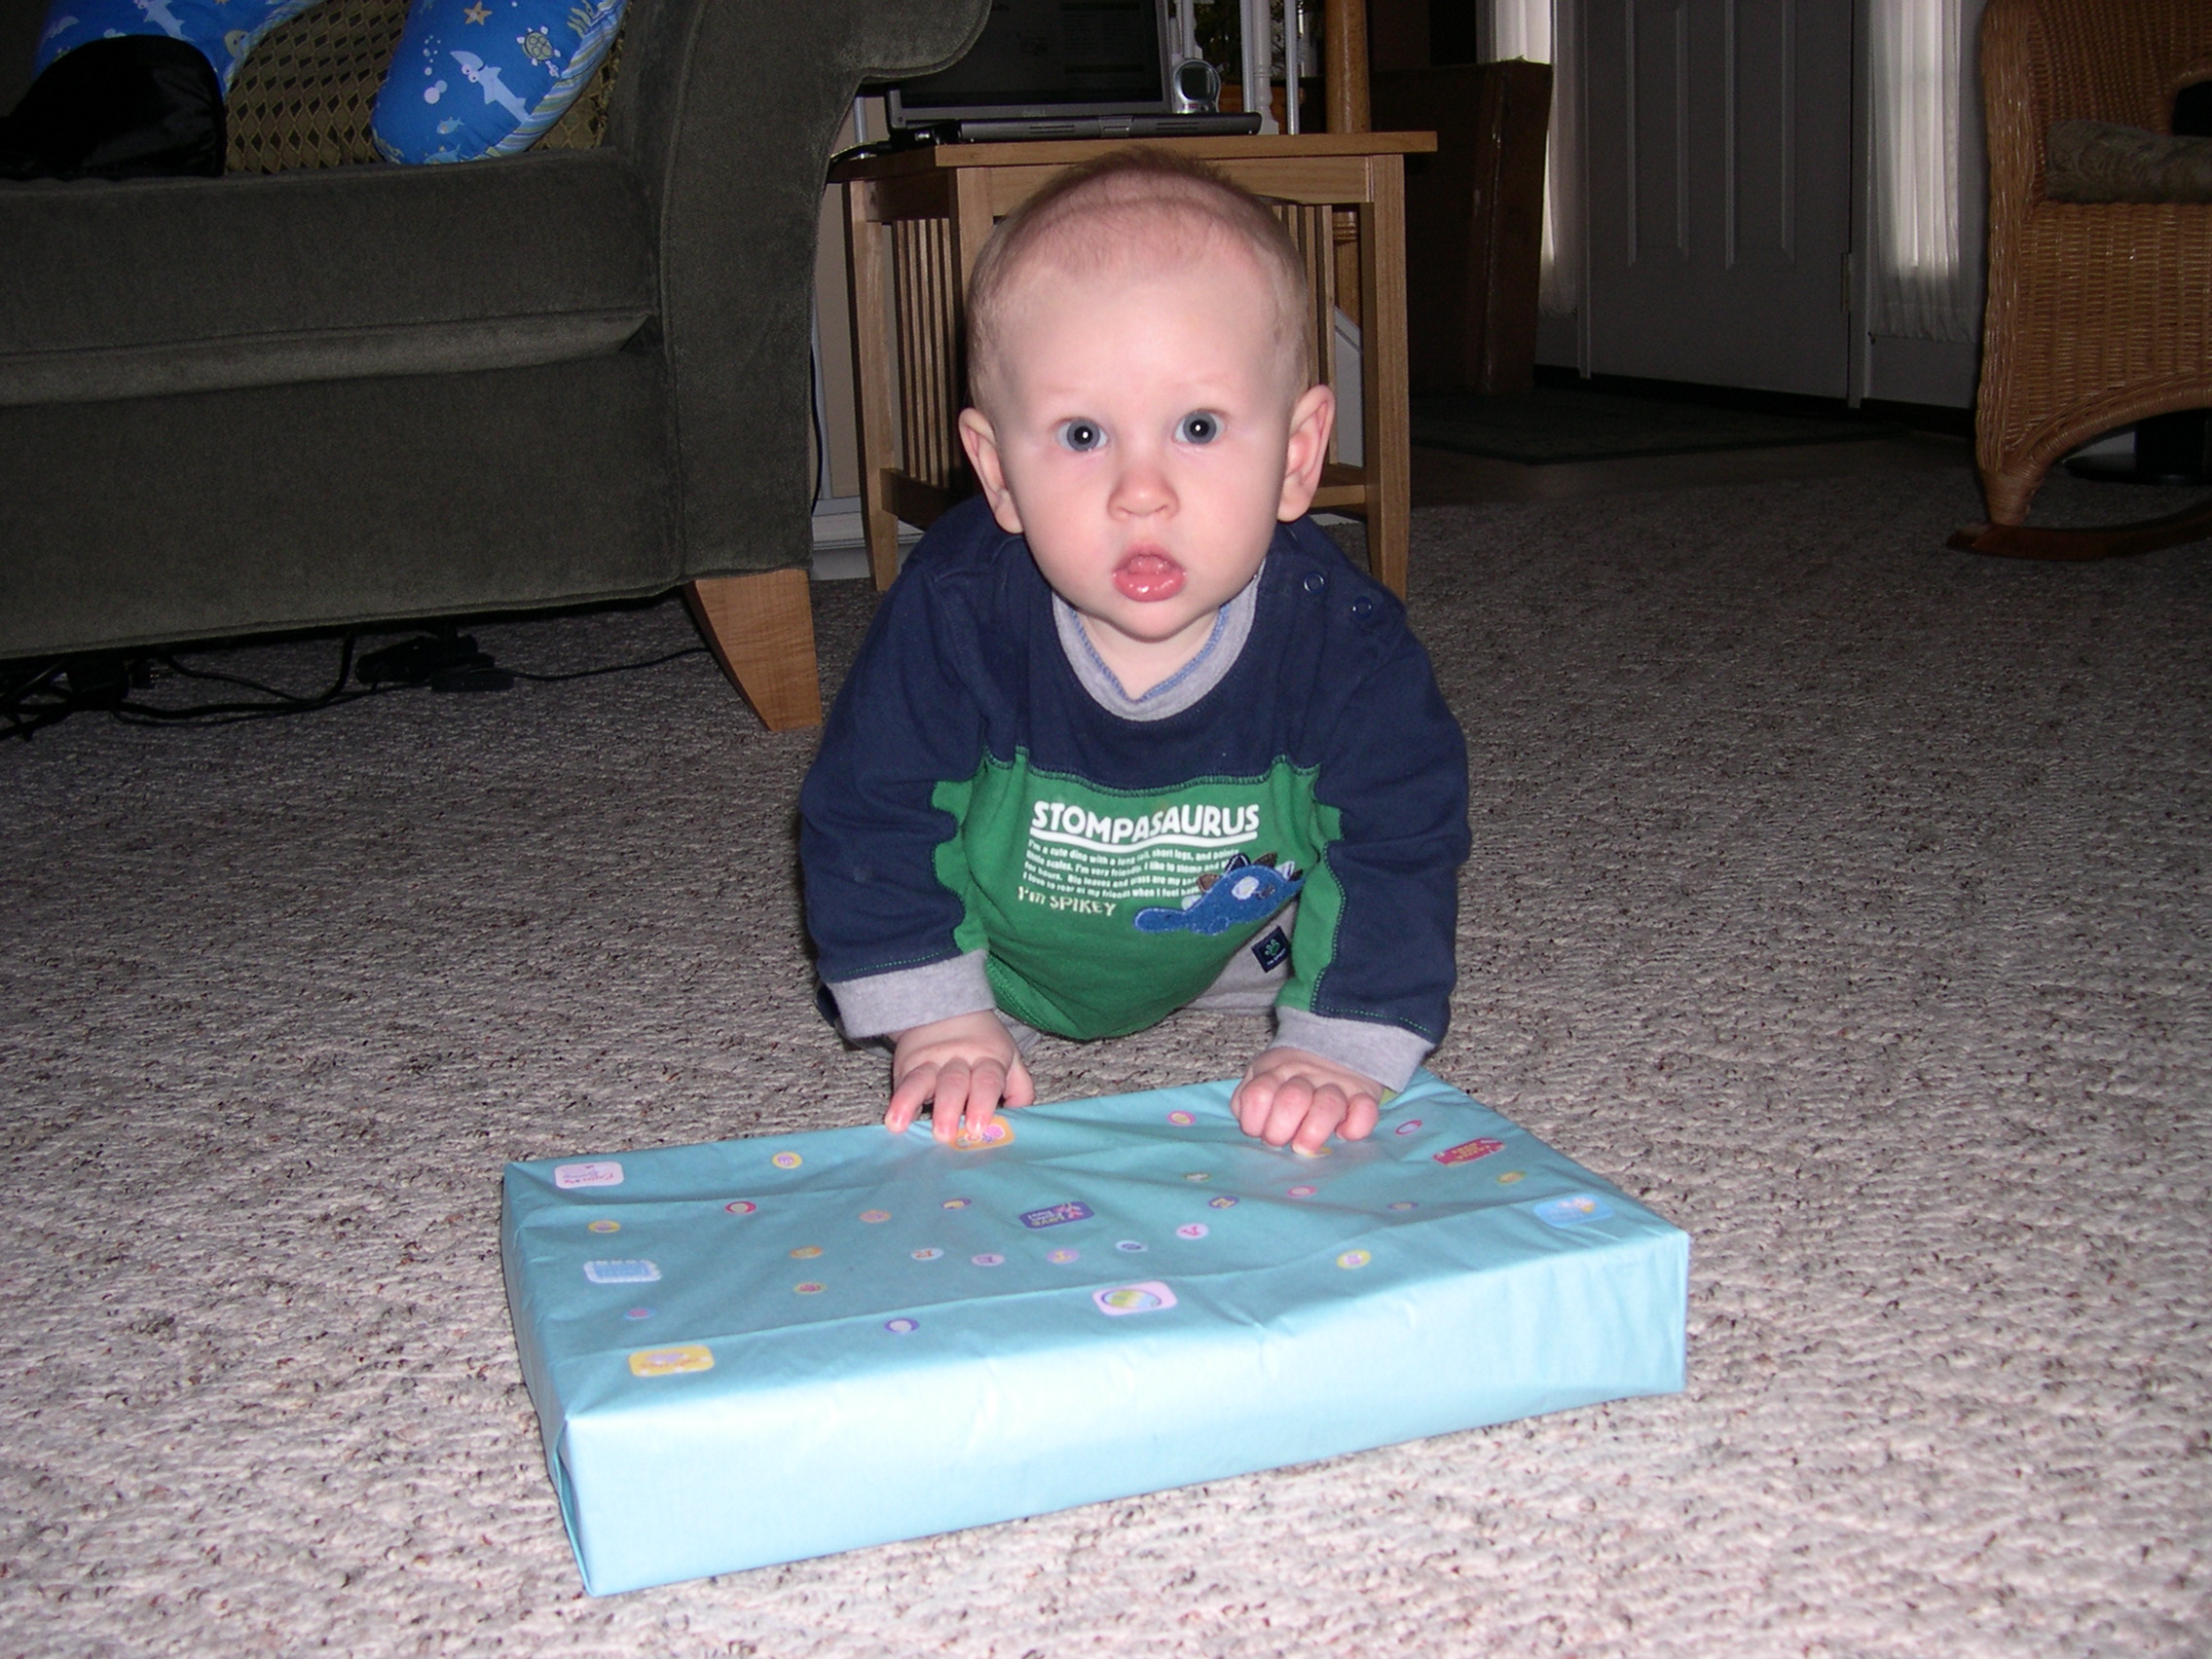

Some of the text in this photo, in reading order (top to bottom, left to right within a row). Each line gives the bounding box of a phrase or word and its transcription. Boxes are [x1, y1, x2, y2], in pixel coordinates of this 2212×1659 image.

[1032, 800, 1259, 844] STOMPASAURUS
[1043, 846, 1049, 855] a
[1050, 847, 1068, 858] cute
[1069, 849, 1088, 862] dino
[1089, 855, 1108, 865] with
[1152, 848, 1173, 858] short
[1196, 852, 1211, 861] and
[1075, 864, 1089, 874] I'm
[1090, 867, 1109, 877] very
[1144, 862, 1149, 870] I
[1149, 861, 1164, 871] like
[1166, 862, 1175, 872] to
[1203, 861, 1219, 871] and
[1022, 870, 1028, 880] I
[1088, 888, 1100, 898] my
[1101, 888, 1130, 899] friends
[1132, 887, 1155, 898] when
[1156, 887, 1161, 897] I
[1161, 887, 1180, 897] feel
[1113, 878, 1128, 888] and
[1152, 875, 1165, 884] are
[1166, 875, 1181, 887] my
[1018, 885, 1117, 916] I'm SPIKEY
